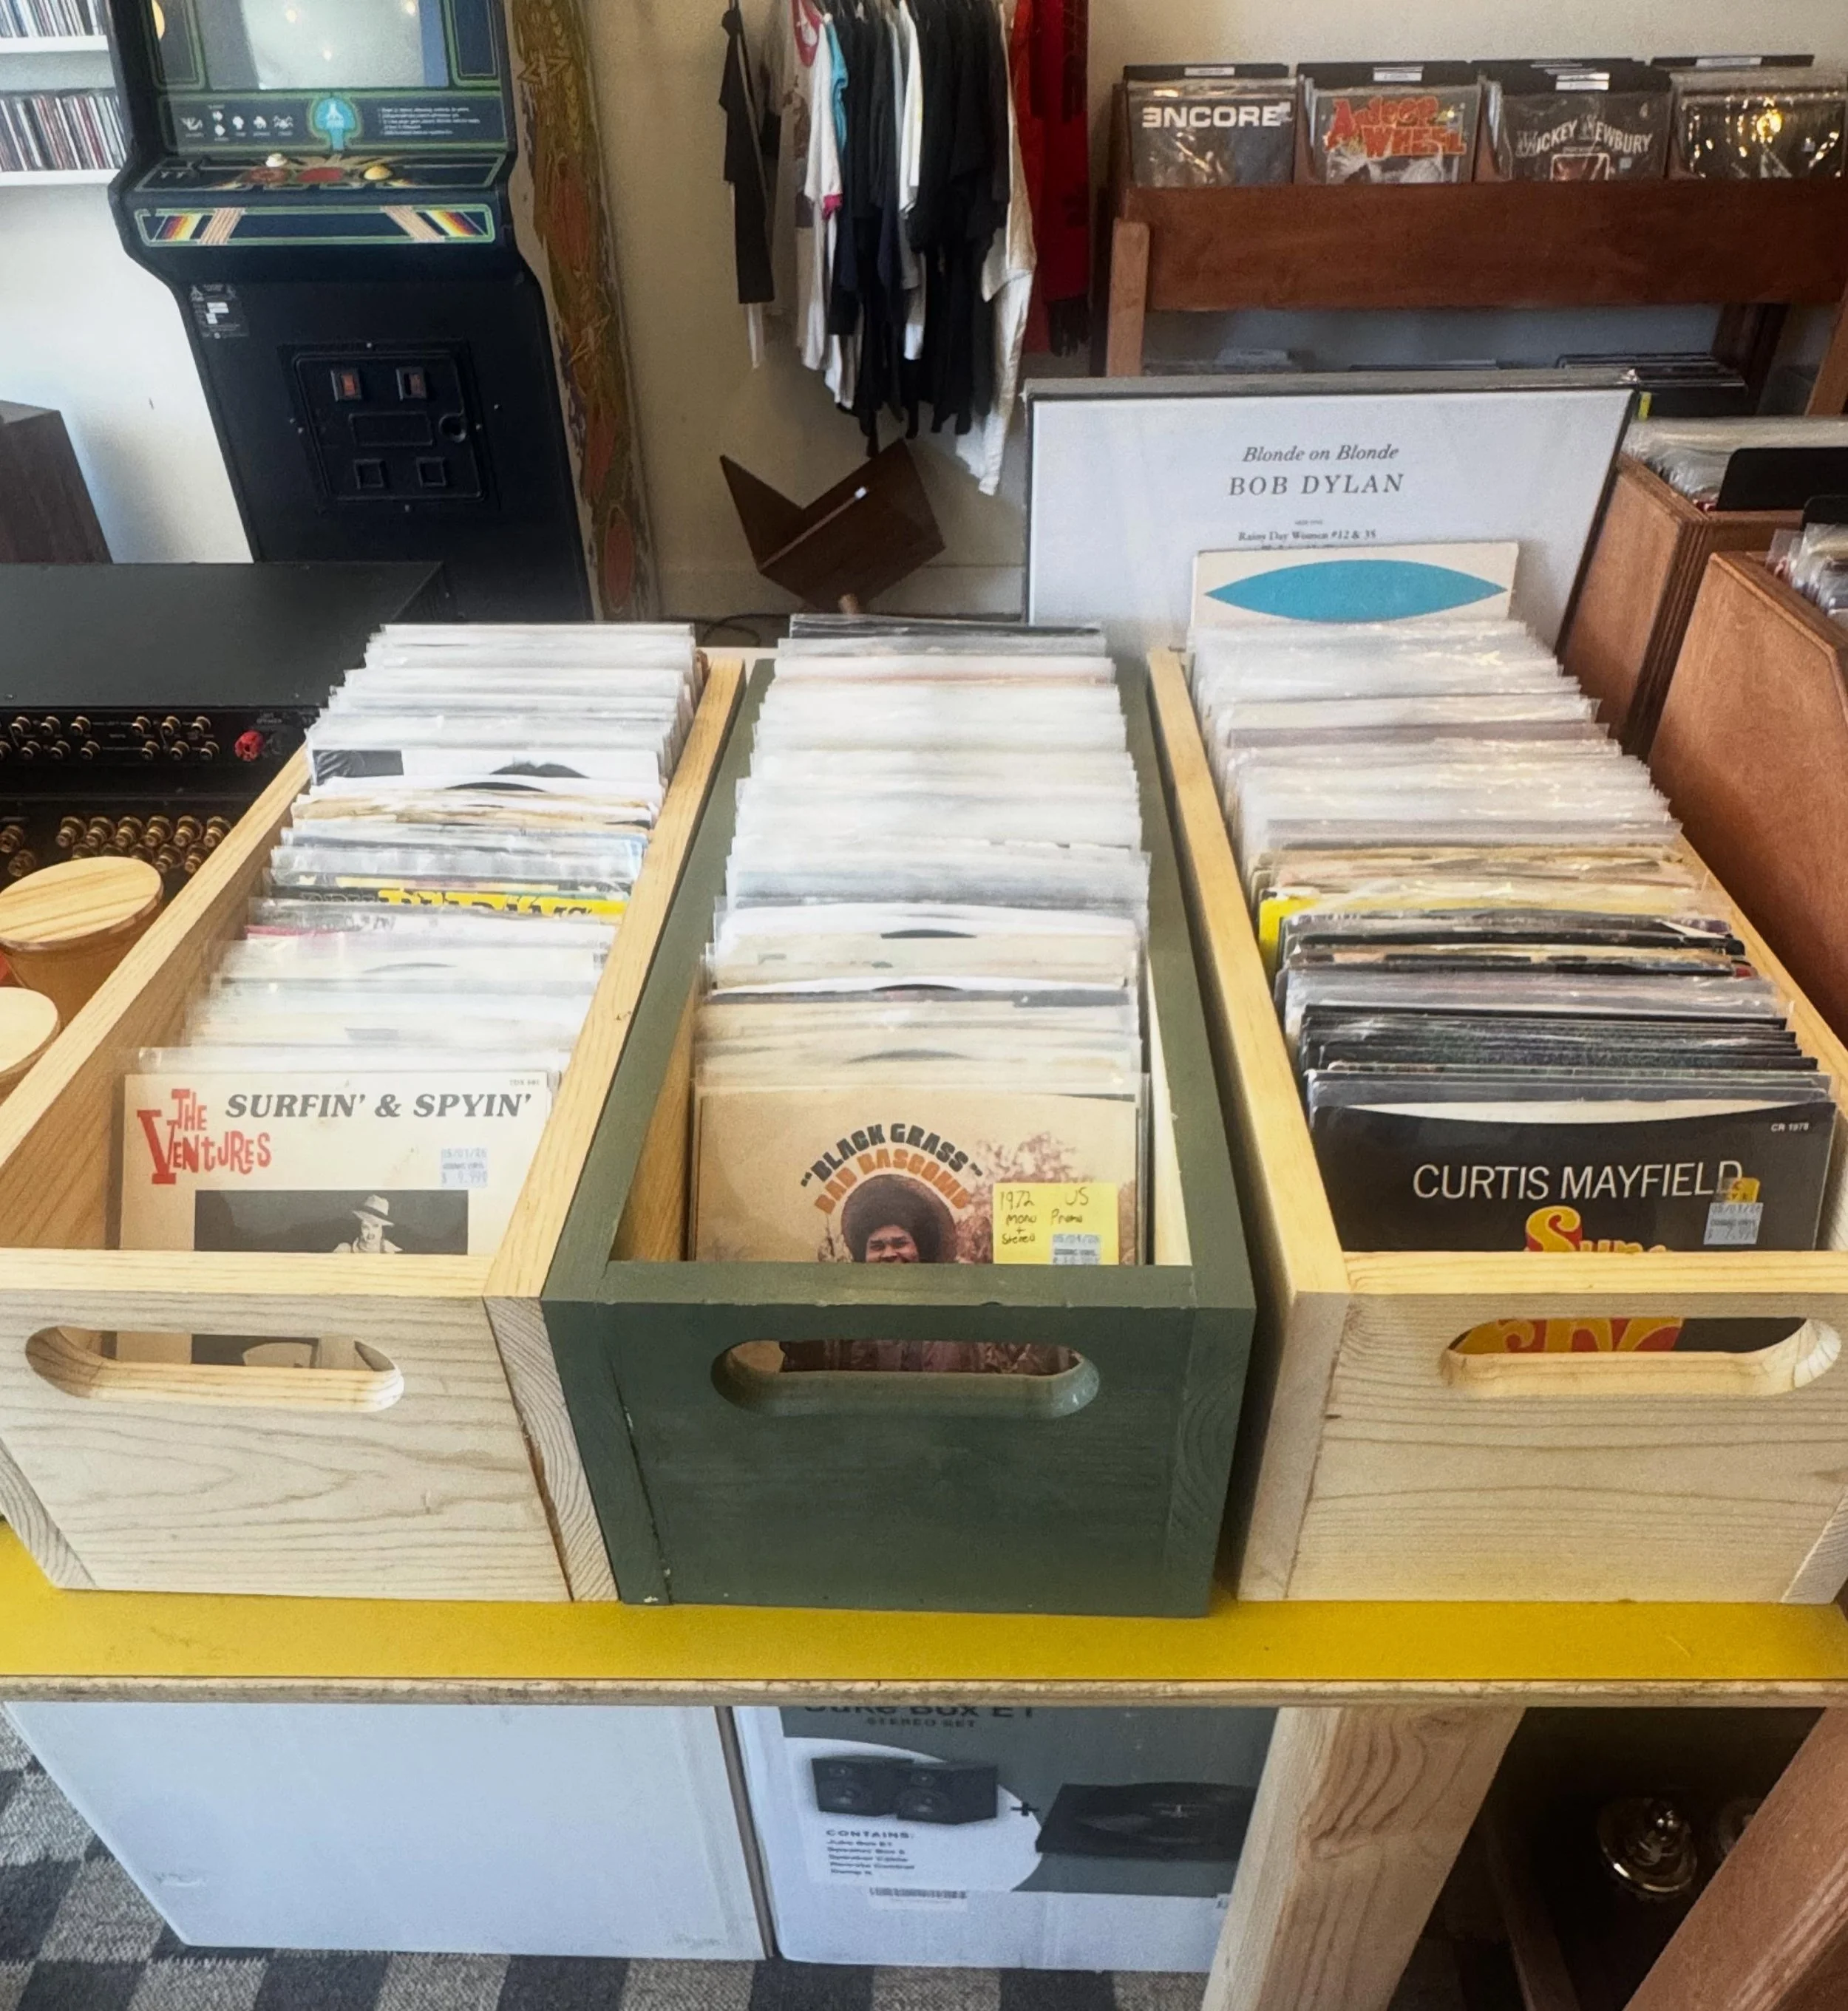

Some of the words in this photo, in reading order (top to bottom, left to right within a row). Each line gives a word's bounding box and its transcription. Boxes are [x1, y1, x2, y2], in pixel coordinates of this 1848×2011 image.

[1142, 106, 1283, 128] ENCORE
[1243, 446, 1305, 462] Blonde
[1308, 450, 1330, 460] on
[1336, 443, 1399, 460] Blonde
[1229, 477, 1288, 496] BOB
[1300, 473, 1404, 494] DYLAN
[225, 1094, 366, 1117] SURFIN'
[375, 1095, 401, 1117] &
[413, 1093, 531, 1117] SPYIN'
[1771, 1123, 1785, 1132] CR
[1413, 1165, 1549, 1200] CURTIS
[1000, 1191, 1035, 1211] 1972
[1065, 1187, 1089, 1205] US
[866, 1718, 937, 1726] STEREO
